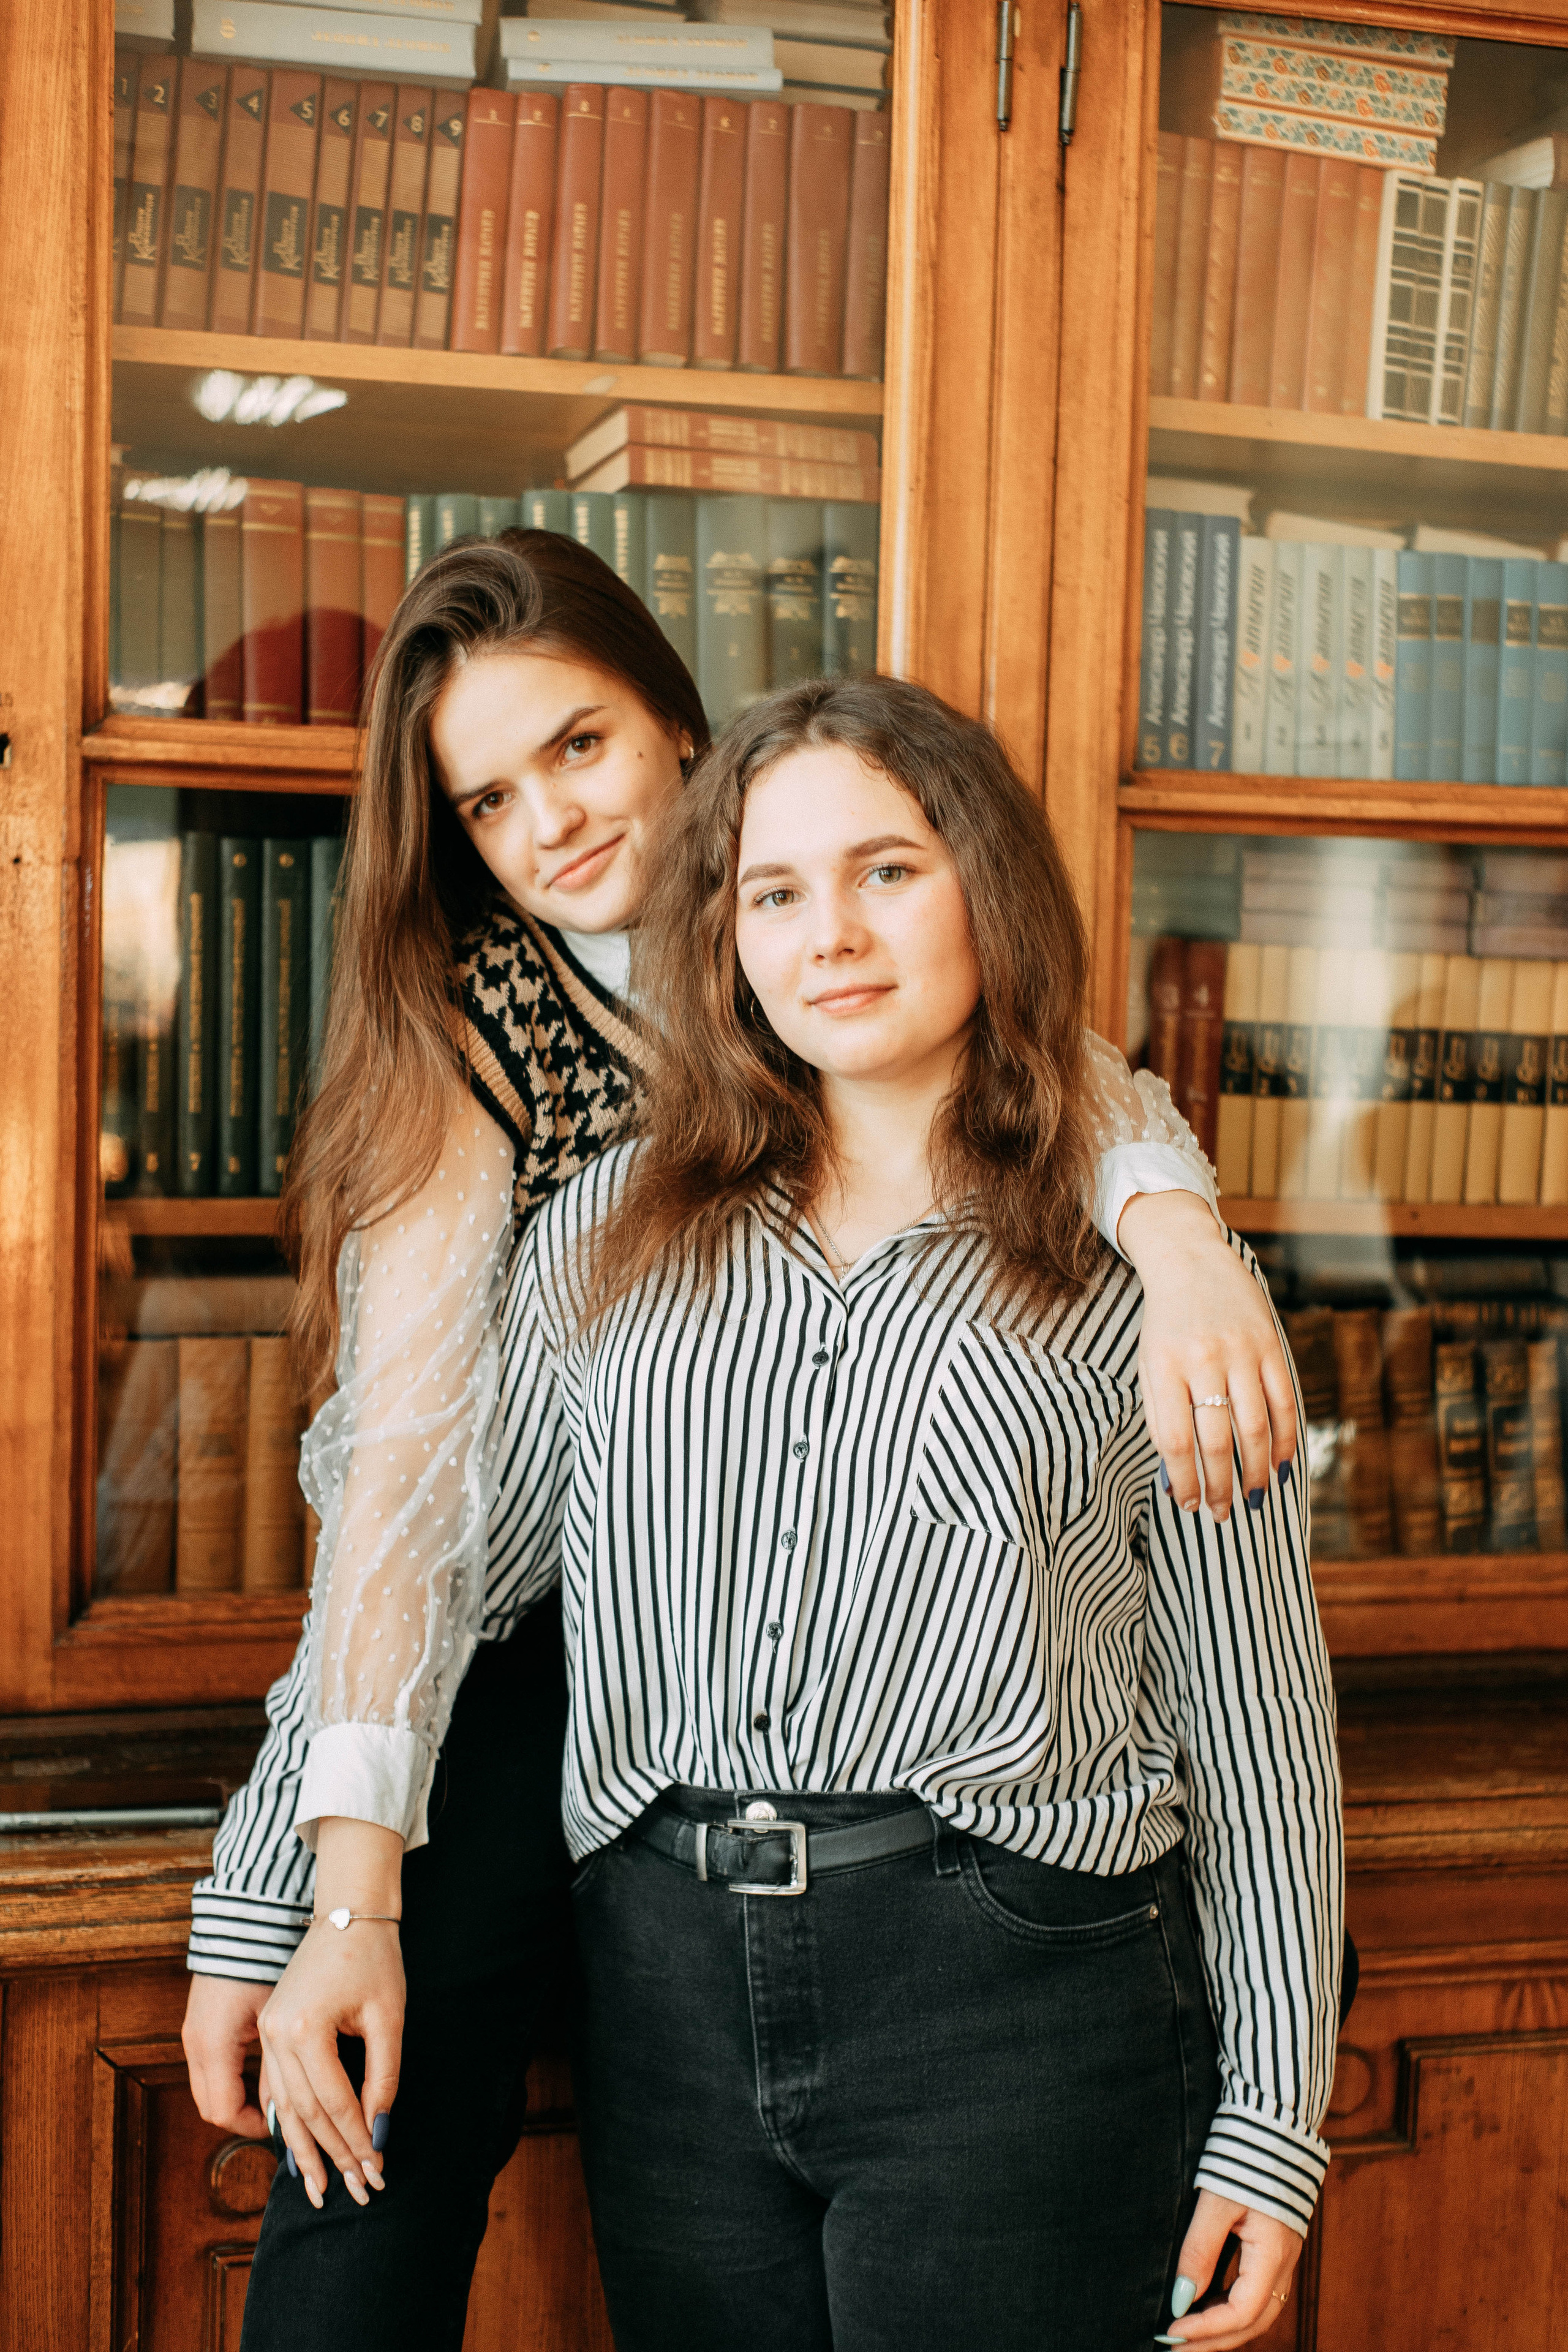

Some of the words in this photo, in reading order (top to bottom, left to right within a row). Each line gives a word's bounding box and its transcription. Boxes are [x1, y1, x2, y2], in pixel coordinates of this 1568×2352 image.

[154, 86, 167, 105] 2
[206, 91, 219, 110] 3
[247, 94, 260, 113] 4
[301, 101, 314, 120] 5
[337, 109, 352, 127] 6
[374, 111, 388, 129] 7
[411, 115, 424, 133] 8
[449, 119, 463, 137] 9
[1142, 735, 1162, 764] 5
[1169, 733, 1189, 763] 6
[1207, 739, 1226, 768] 7
